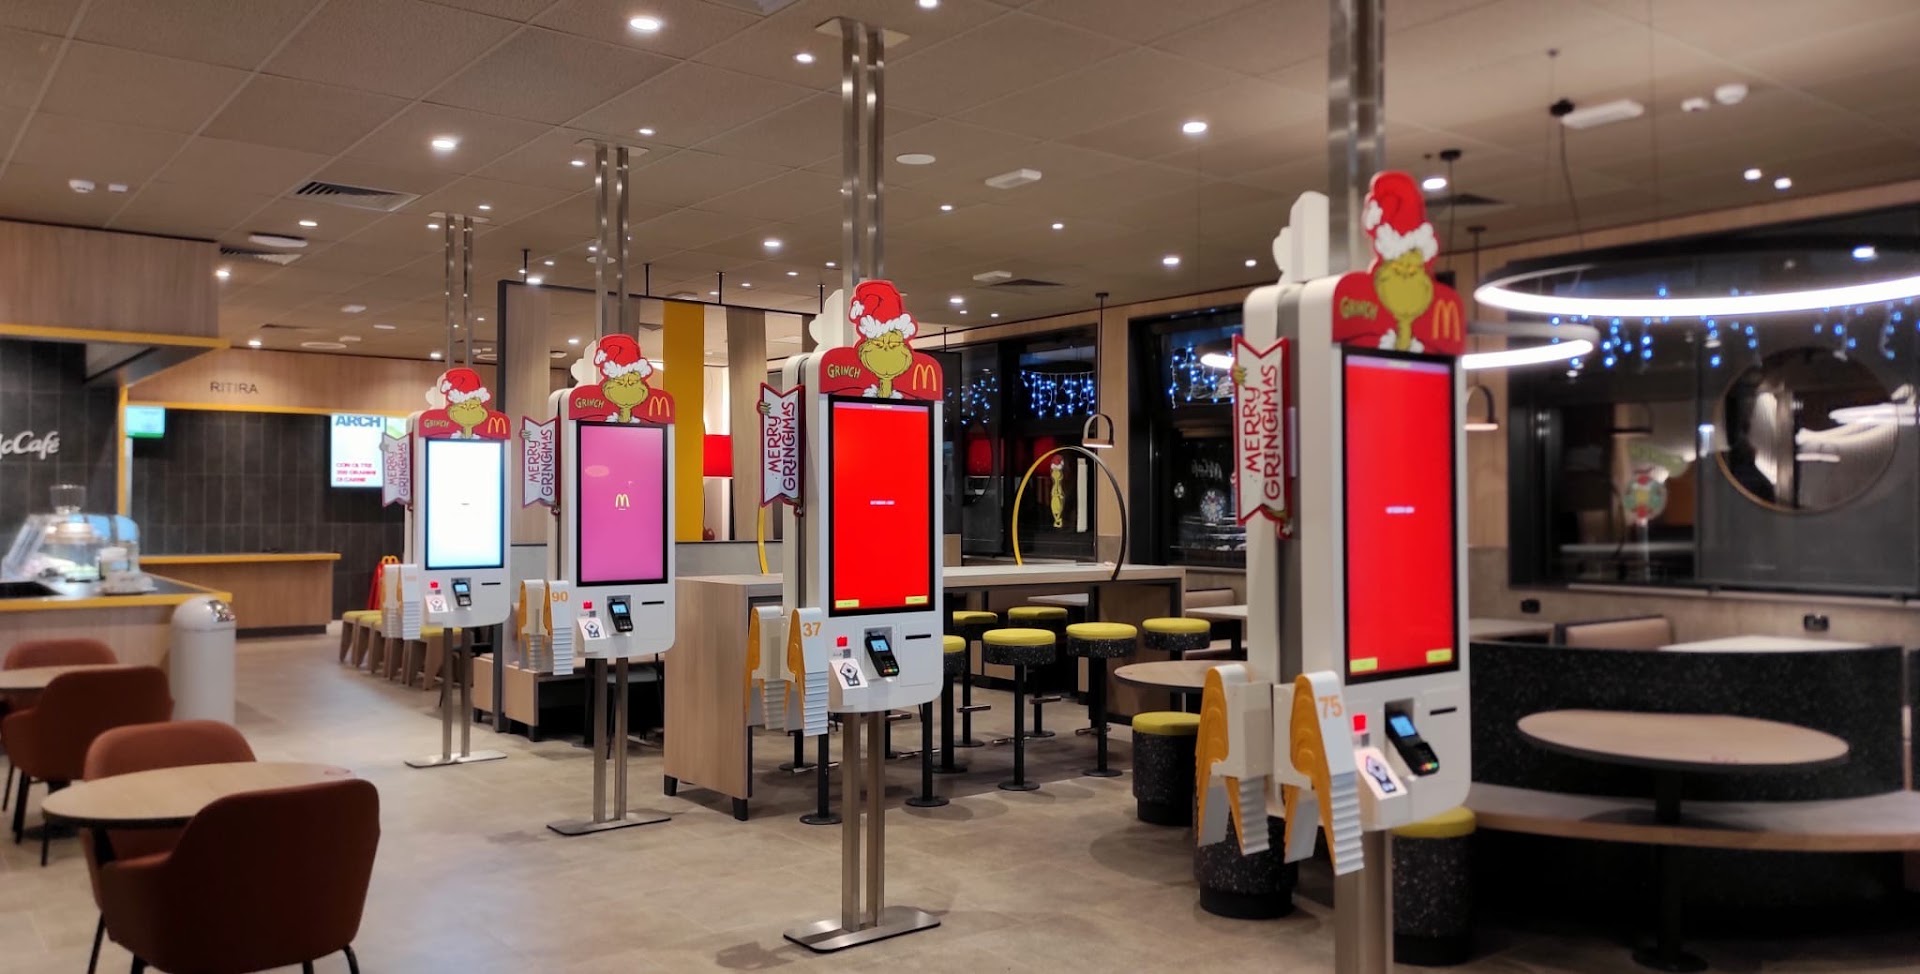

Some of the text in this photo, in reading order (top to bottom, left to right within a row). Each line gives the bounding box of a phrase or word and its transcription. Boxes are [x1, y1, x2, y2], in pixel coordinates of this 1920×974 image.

[1340, 296, 1378, 320] GRINCH
[827, 363, 861, 379] GRINCH
[210, 381, 259, 394] RITIRA
[575, 397, 604, 410] GRINCH
[335, 415, 381, 428] ARCH
[424, 419, 449, 429] GRINCH
[1243, 386, 1261, 472] MERRY
[0, 430, 60, 460] cCafé
[767, 416, 782, 473] MERRY
[527, 439, 541, 483] MERRY
[552, 591, 568, 602] 90
[803, 622, 822, 637] 37
[1319, 695, 1343, 719] 75
